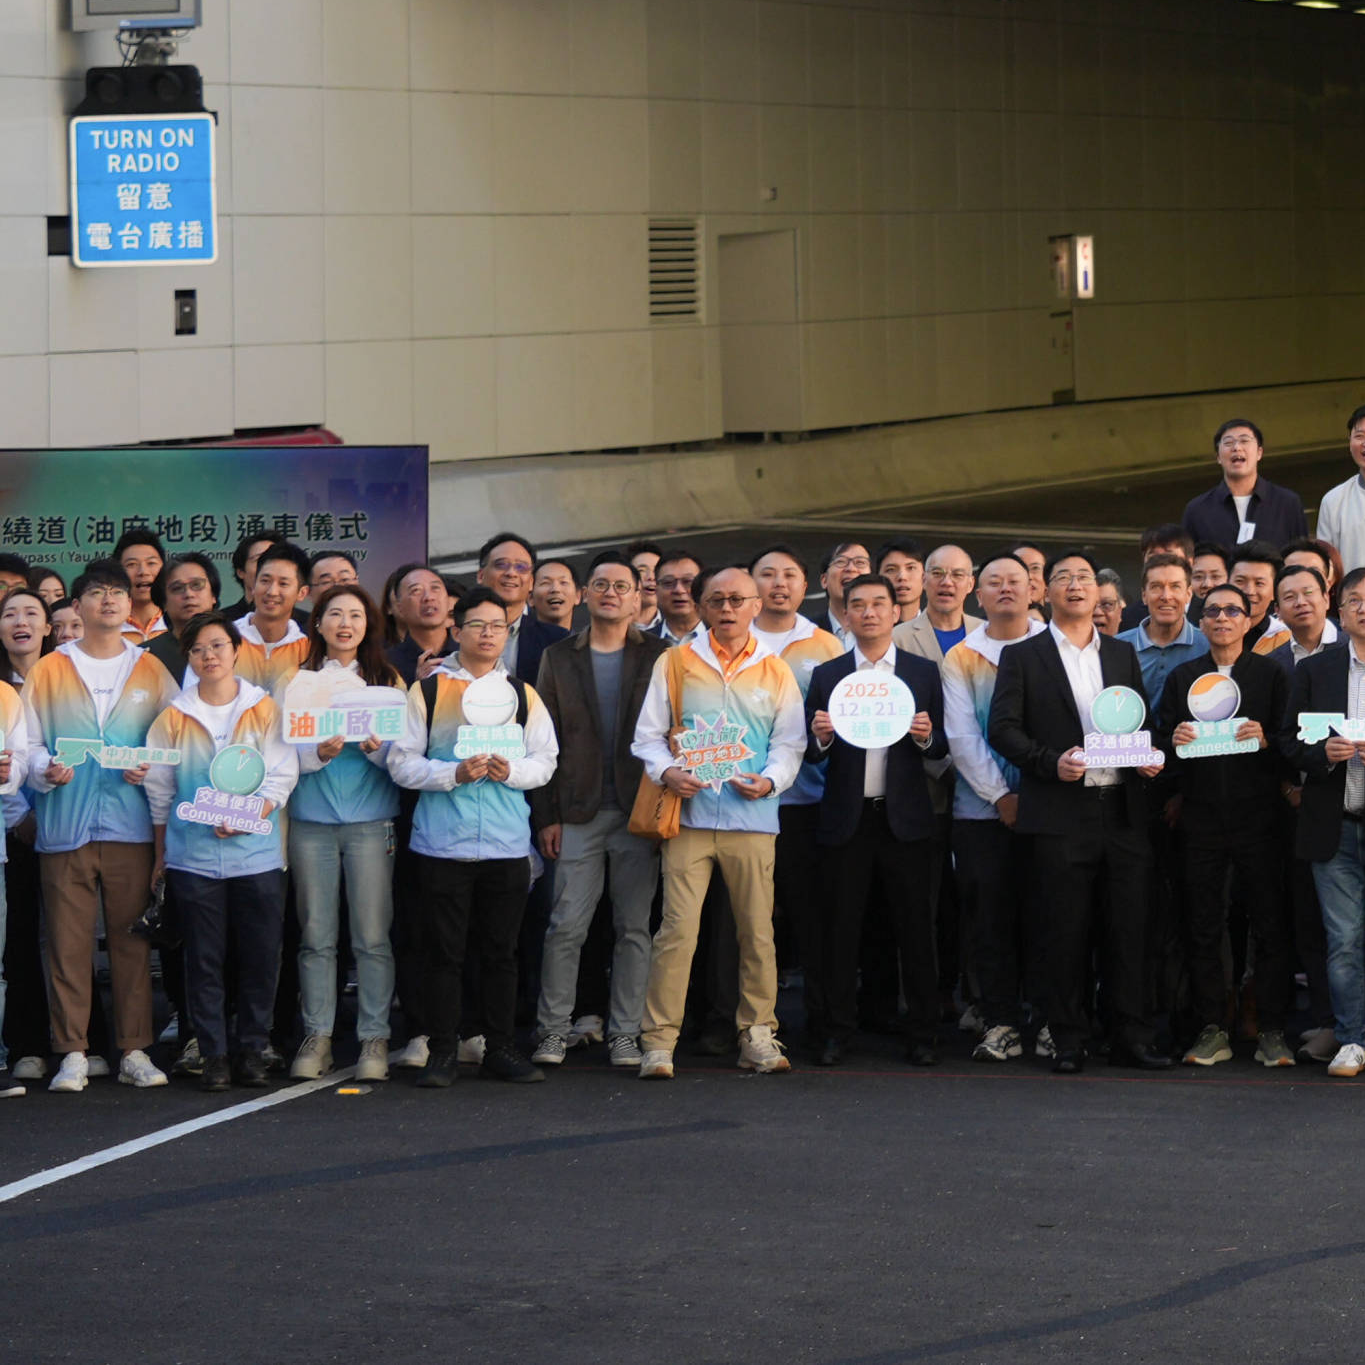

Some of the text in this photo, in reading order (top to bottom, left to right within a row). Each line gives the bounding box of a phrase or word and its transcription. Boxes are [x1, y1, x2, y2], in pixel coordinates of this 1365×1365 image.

[89, 128, 194, 150] TURN ON
[107, 151, 180, 173] RADIO
[116, 182, 173, 211] 留意
[86, 220, 204, 250] 電台廣播
[1178, 739, 1258, 757] Connection
[179, 804, 271, 833] Convenience
